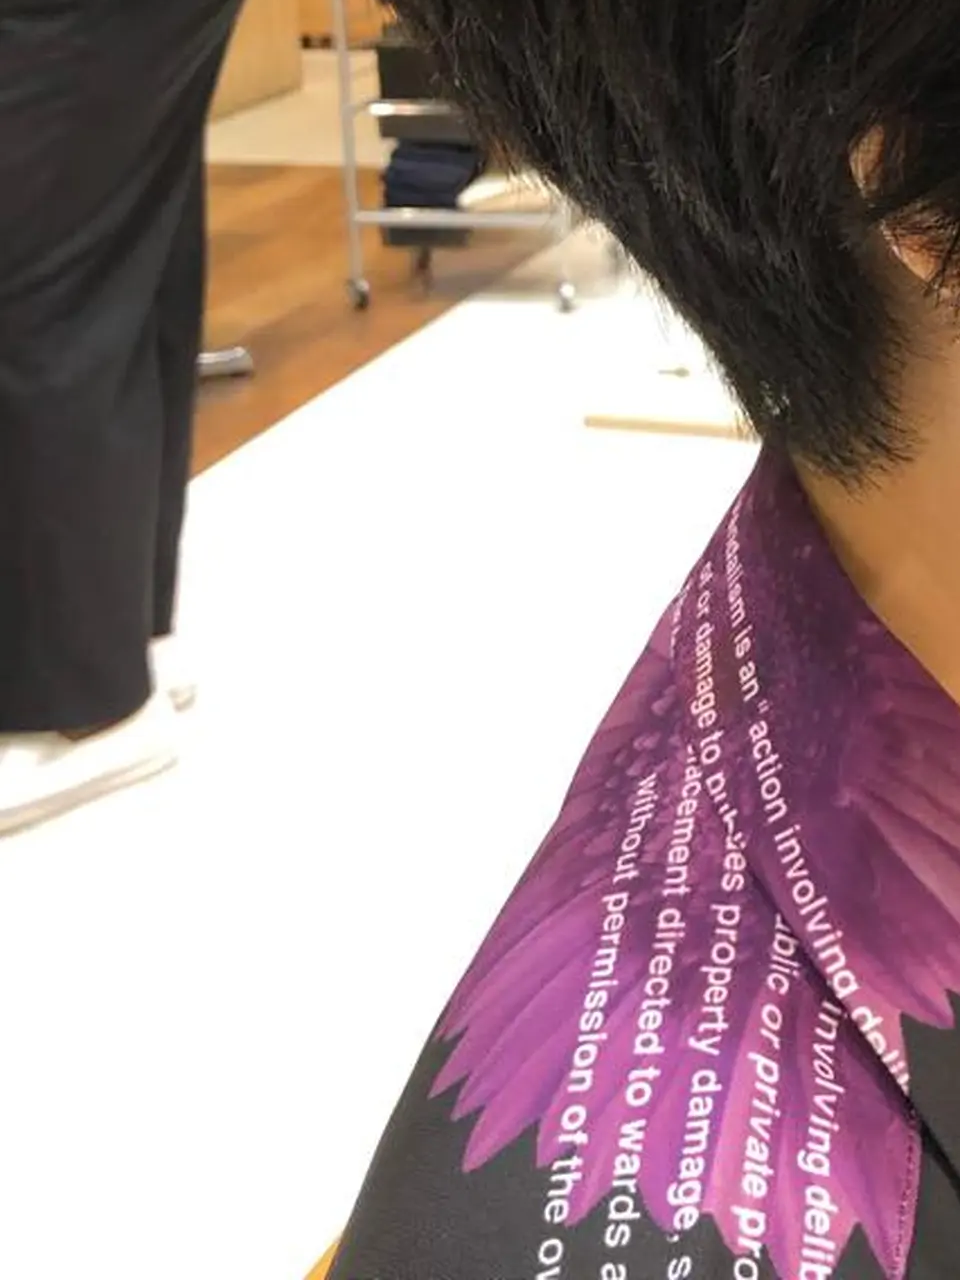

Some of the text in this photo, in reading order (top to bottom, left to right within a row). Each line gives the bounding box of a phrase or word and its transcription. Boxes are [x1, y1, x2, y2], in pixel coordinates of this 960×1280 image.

[697, 590, 710, 618] or
[733, 624, 752, 658] is
[691, 622, 717, 728] damage
[739, 661, 759, 702] an
[700, 730, 724, 764] to
[749, 720, 788, 823] action
[613, 773, 659, 884] without
[774, 824, 861, 998] involving
[567, 892, 630, 1093] permission
[633, 907, 686, 1055] directed
[688, 903, 741, 1056] property
[760, 1003, 783, 1050] or
[558, 1104, 588, 1144] of
[625, 1065, 661, 1107] to
[741, 1051, 781, 1199] private
[797, 999, 849, 1177] involving
[544, 1155, 583, 1224] the
[604, 1118, 647, 1248] wards
[730, 1205, 767, 1280] pro
